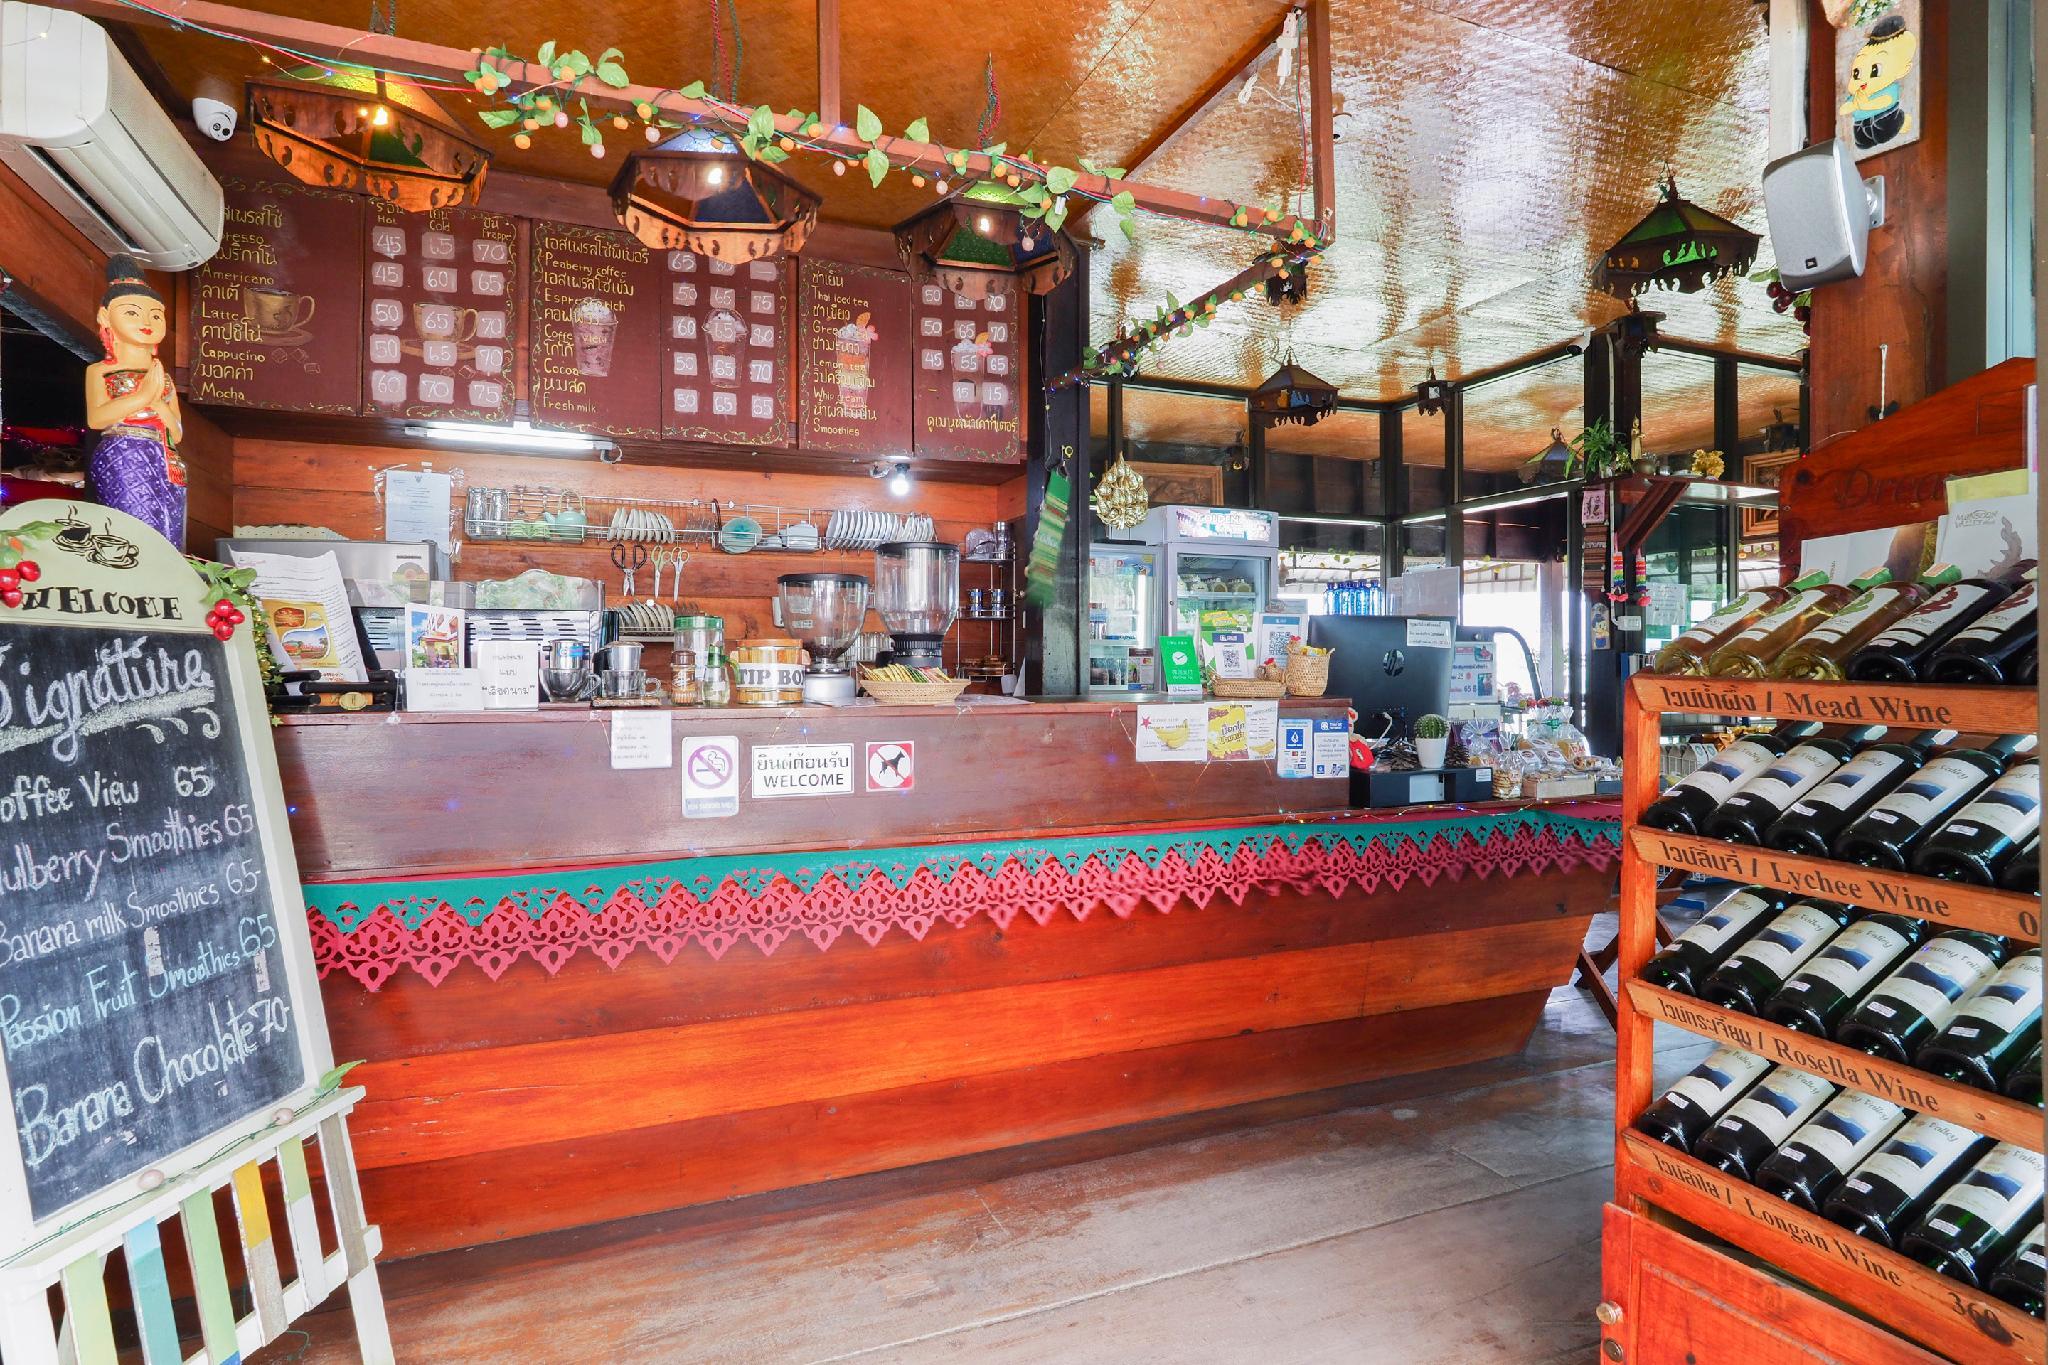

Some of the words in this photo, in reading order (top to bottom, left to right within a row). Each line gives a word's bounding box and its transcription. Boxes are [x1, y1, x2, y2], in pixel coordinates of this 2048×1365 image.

[429, 219, 450, 232] Cold
[376, 233, 402, 254] 45
[478, 244, 504, 261] 70
[545, 251, 593, 276] Peaberry
[671, 253, 697, 270] 65
[201, 263, 275, 286] Americano
[375, 266, 399, 283] 45
[427, 270, 449, 288] 60
[478, 275, 502, 292] 65
[676, 287, 698, 301] 50
[714, 288, 733, 304] 65
[853, 296, 870, 308] tea
[925, 289, 942, 302] 50
[987, 295, 1004, 310] 70
[753, 296, 772, 311] 75
[375, 304, 400, 322] 50
[425, 311, 449, 329] 65
[481, 318, 503, 336] 70
[677, 320, 696, 336] 60
[753, 328, 774, 343] 80
[924, 321, 943, 336] 50
[958, 323, 977, 339] 65
[990, 326, 1006, 342] 70
[375, 339, 399, 358] 50
[428, 346, 451, 361] 65
[479, 349, 504, 367] 70
[675, 357, 696, 371] 50
[925, 352, 943, 368] 45
[961, 355, 977, 371] 55
[990, 355, 1006, 371] 65
[544, 358, 580, 376] Cocoa
[714, 362, 734, 377] 65
[752, 365, 772, 381] 70
[200, 381, 245, 401] Mocha
[377, 374, 401, 393] 60
[421, 380, 450, 399] 70
[543, 377, 587, 395] นมสด
[473, 385, 500, 403] 75
[676, 393, 696, 408] 50
[813, 386, 834, 401] Whip
[577, 399, 597, 414] milk
[714, 397, 733, 412] 65
[753, 400, 773, 416] 65
[814, 418, 860, 437] Smoothies
[21, 586, 183, 620] WELCOME
[740, 669, 770, 685] TIP
[1660, 683, 1757, 712] ไวน์น้ำผึ้ง
[1784, 692, 1862, 719] Mead
[1866, 696, 1953, 725] Wine
[764, 774, 845, 788] WELCOME
[0, 774, 73, 822] offee
[79, 770, 140, 807] View
[173, 765, 216, 797] 65
[0, 838, 104, 902] ulberry
[106, 806, 223, 863] Smoothies
[224, 804, 254, 836] 65
[1770, 861, 1862, 901] Lychee
[1867, 880, 1951, 917] Wine
[84, 901, 127, 940] milk
[127, 882, 220, 929] Smoothies
[85, 960, 139, 1021] Fruit
[238, 913, 277, 957] 65
[15, 1082, 136, 1170] Banana
[133, 994, 258, 1103] Chocolate
[1773, 1037, 1860, 1085] Rosella
[1865, 1068, 1939, 1112] Wine
[1745, 1197, 1830, 1254] Longan
[1834, 1239, 1902, 1287] Wine
